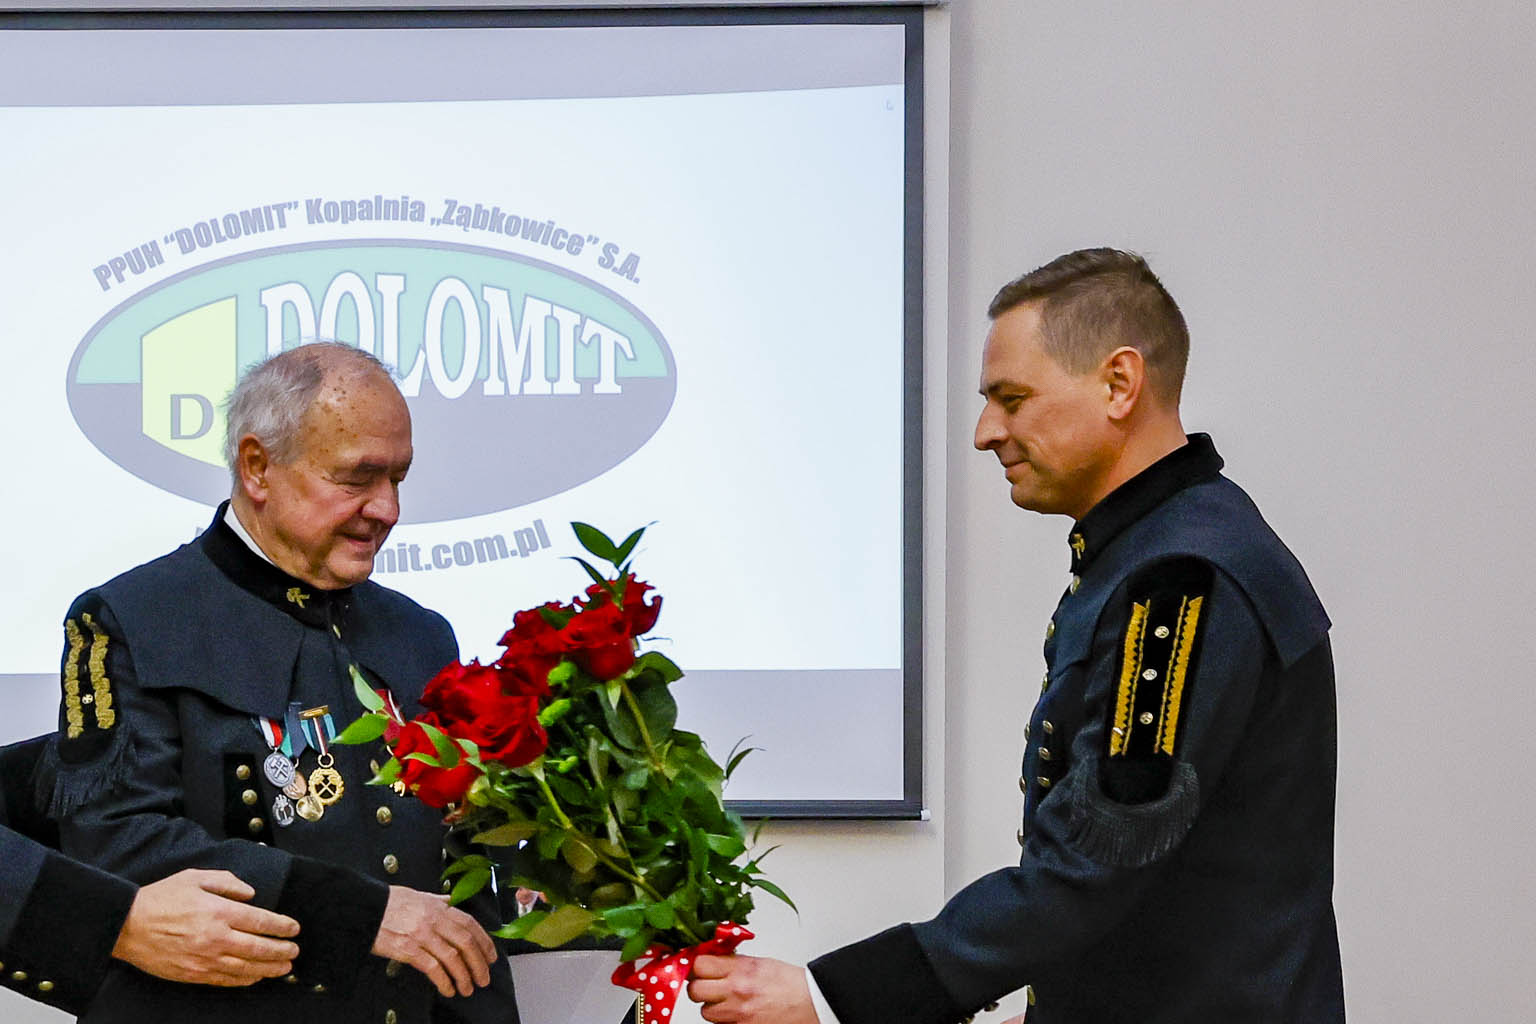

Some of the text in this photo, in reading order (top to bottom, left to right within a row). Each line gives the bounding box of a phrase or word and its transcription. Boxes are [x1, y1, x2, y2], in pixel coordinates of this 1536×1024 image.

[93, 239, 164, 292] PPUH
[305, 194, 425, 225] Kopalnia
[597, 242, 642, 284] S.A.
[260, 270, 638, 400] DOLOMIT
[170, 393, 214, 440] D
